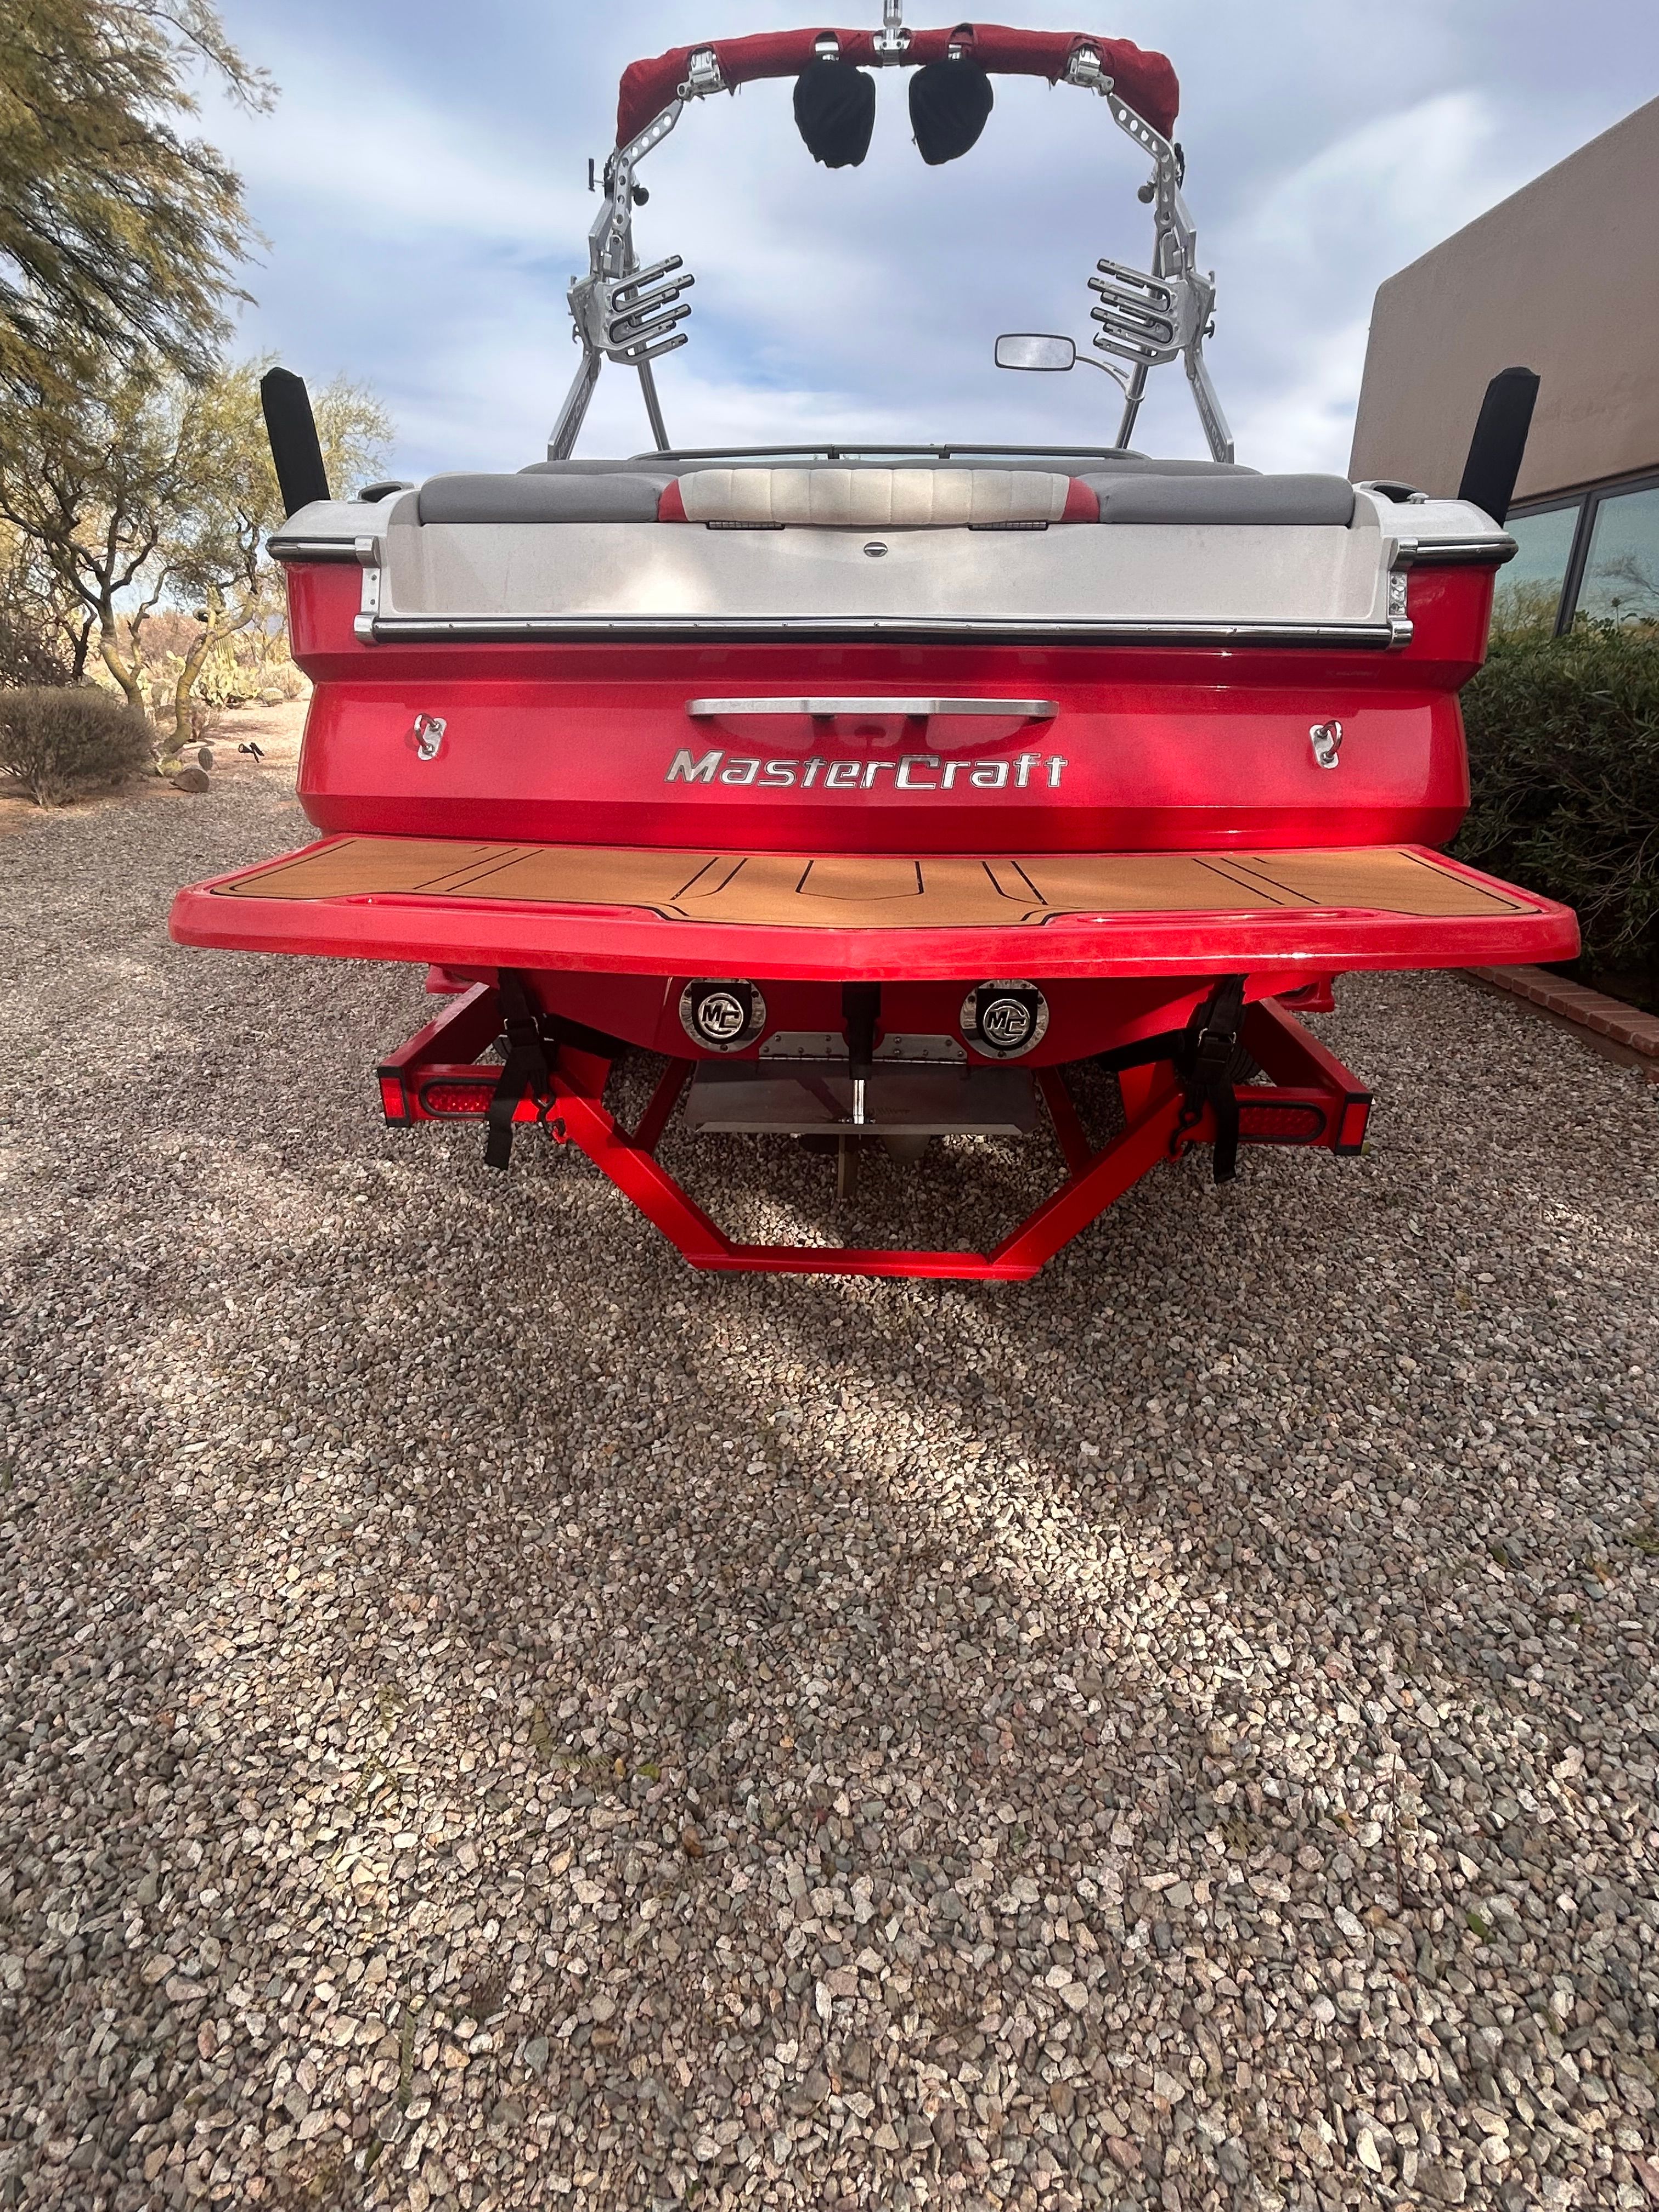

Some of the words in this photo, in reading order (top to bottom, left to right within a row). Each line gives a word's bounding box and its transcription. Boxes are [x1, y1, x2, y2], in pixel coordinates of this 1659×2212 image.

[663, 748, 1070, 791] MasterCraft
[701, 1005, 740, 1028] MC
[986, 1010, 1026, 1035] MC
